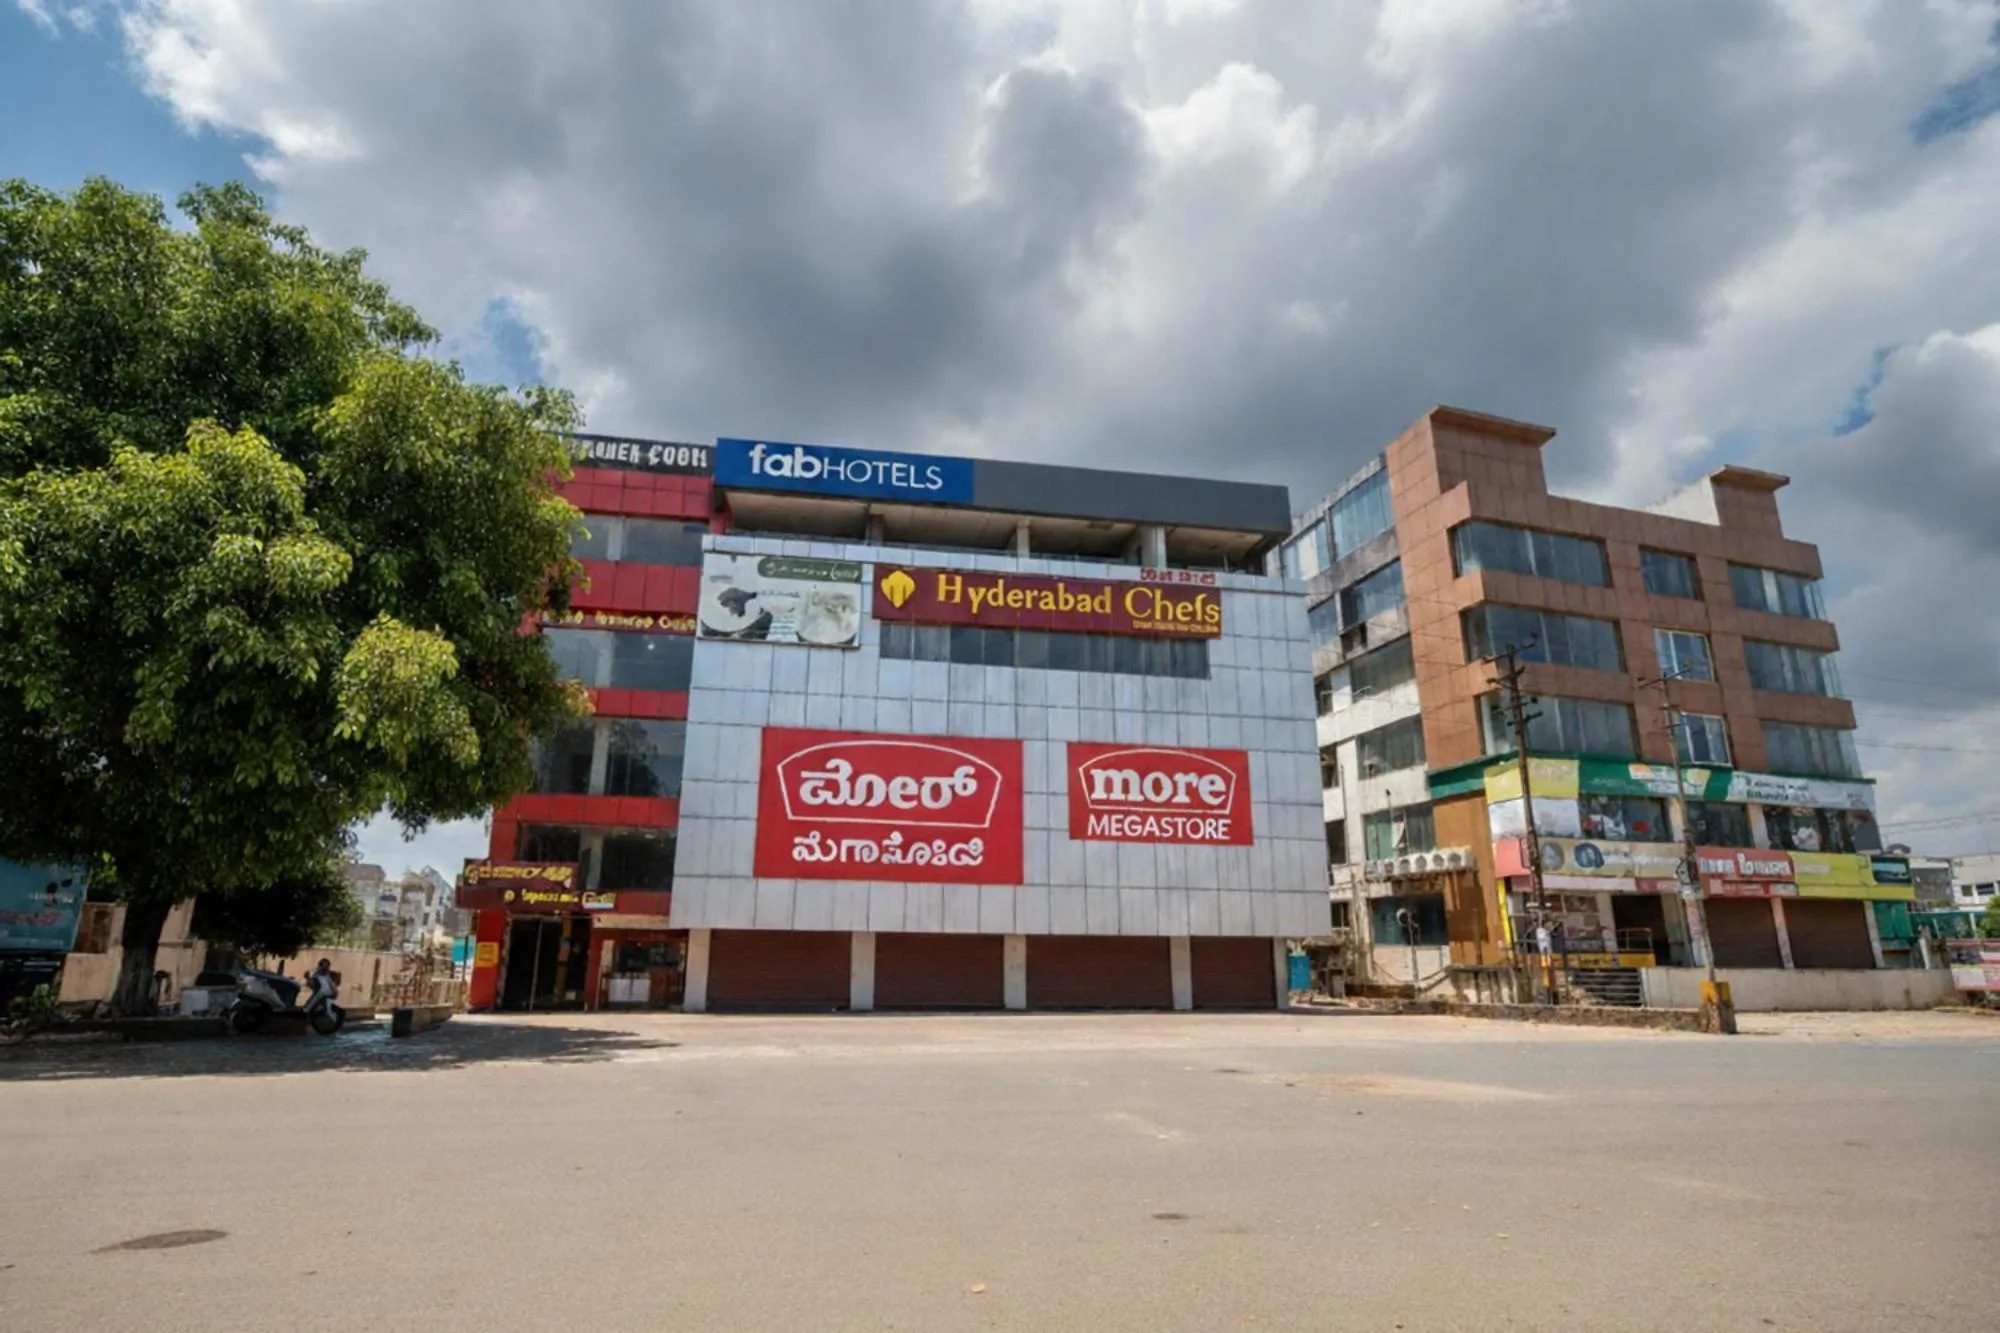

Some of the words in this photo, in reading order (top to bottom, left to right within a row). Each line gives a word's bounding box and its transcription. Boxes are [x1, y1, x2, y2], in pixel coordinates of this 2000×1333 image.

[749, 443, 943, 490] fabHOTELS
[937, 574, 1112, 614] Hyderabad
[1090, 768, 1226, 805] more
[1087, 814, 1231, 840] MEGASTORE
